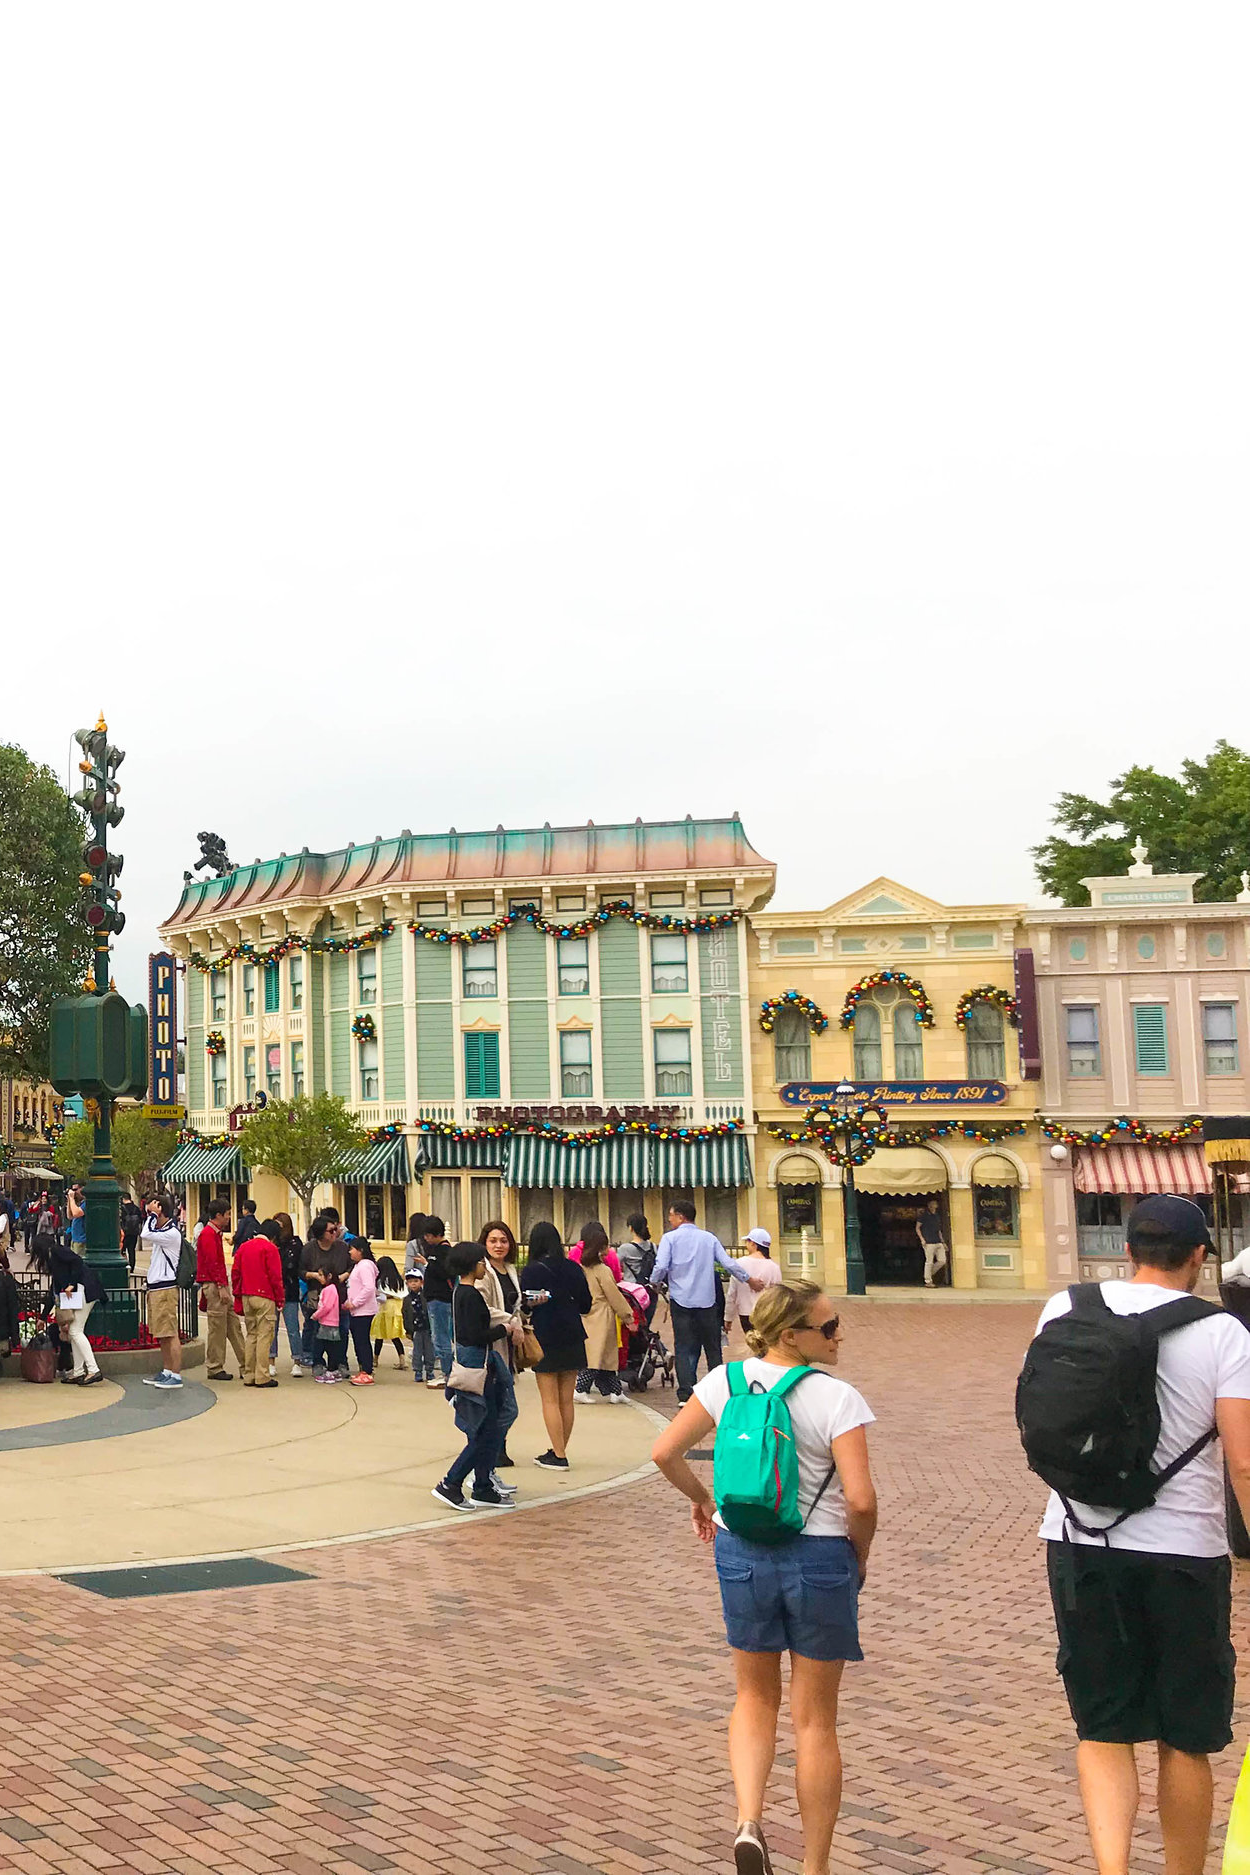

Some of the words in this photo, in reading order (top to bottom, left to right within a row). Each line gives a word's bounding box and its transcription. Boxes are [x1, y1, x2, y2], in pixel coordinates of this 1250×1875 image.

[155, 966, 172, 1101] PHOTO
[798, 1088, 833, 1103] Expert
[870, 1087, 917, 1103] Printing
[920, 1087, 951, 1100] Since
[954, 1087, 988, 1099] 1891
[476, 1106, 680, 1121] PHOTOGRAPHY
